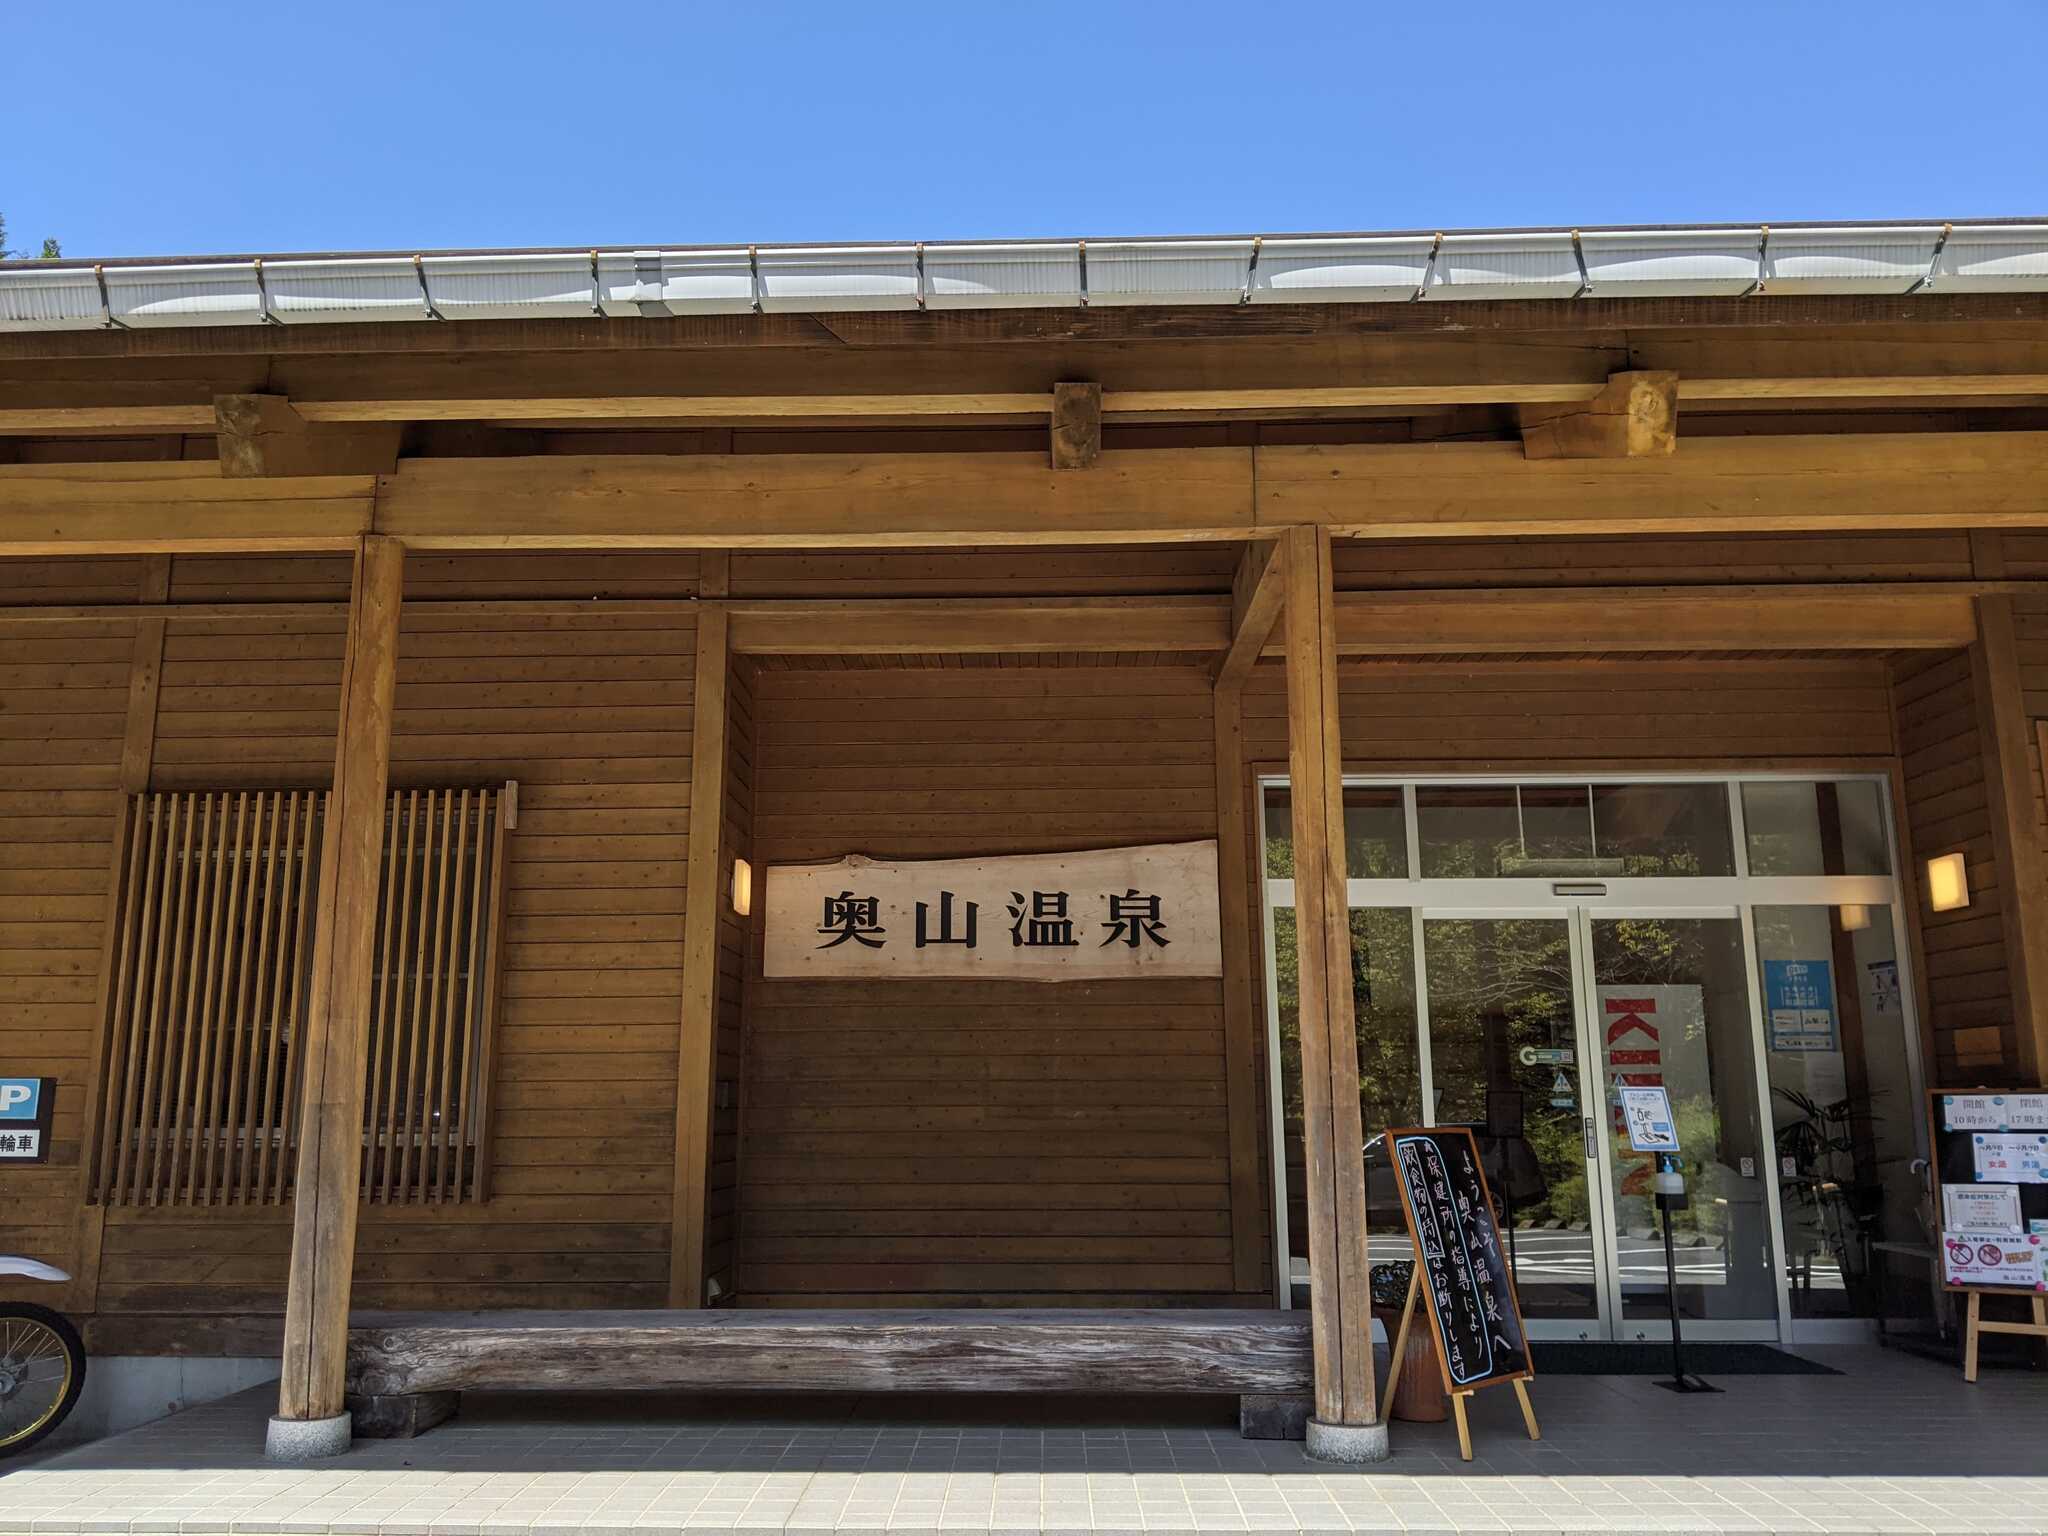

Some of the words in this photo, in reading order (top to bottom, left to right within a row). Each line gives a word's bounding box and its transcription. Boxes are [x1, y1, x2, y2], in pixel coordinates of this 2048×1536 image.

[816, 889, 1172, 950] 奥山温泉
[0, 1085, 32, 1111] P
[2011, 1115, 2048, 1125] 17時ま
[1462, 1150, 1496, 1258] ようこそ
[1457, 1190, 1512, 1353] 奥山温泉へ
